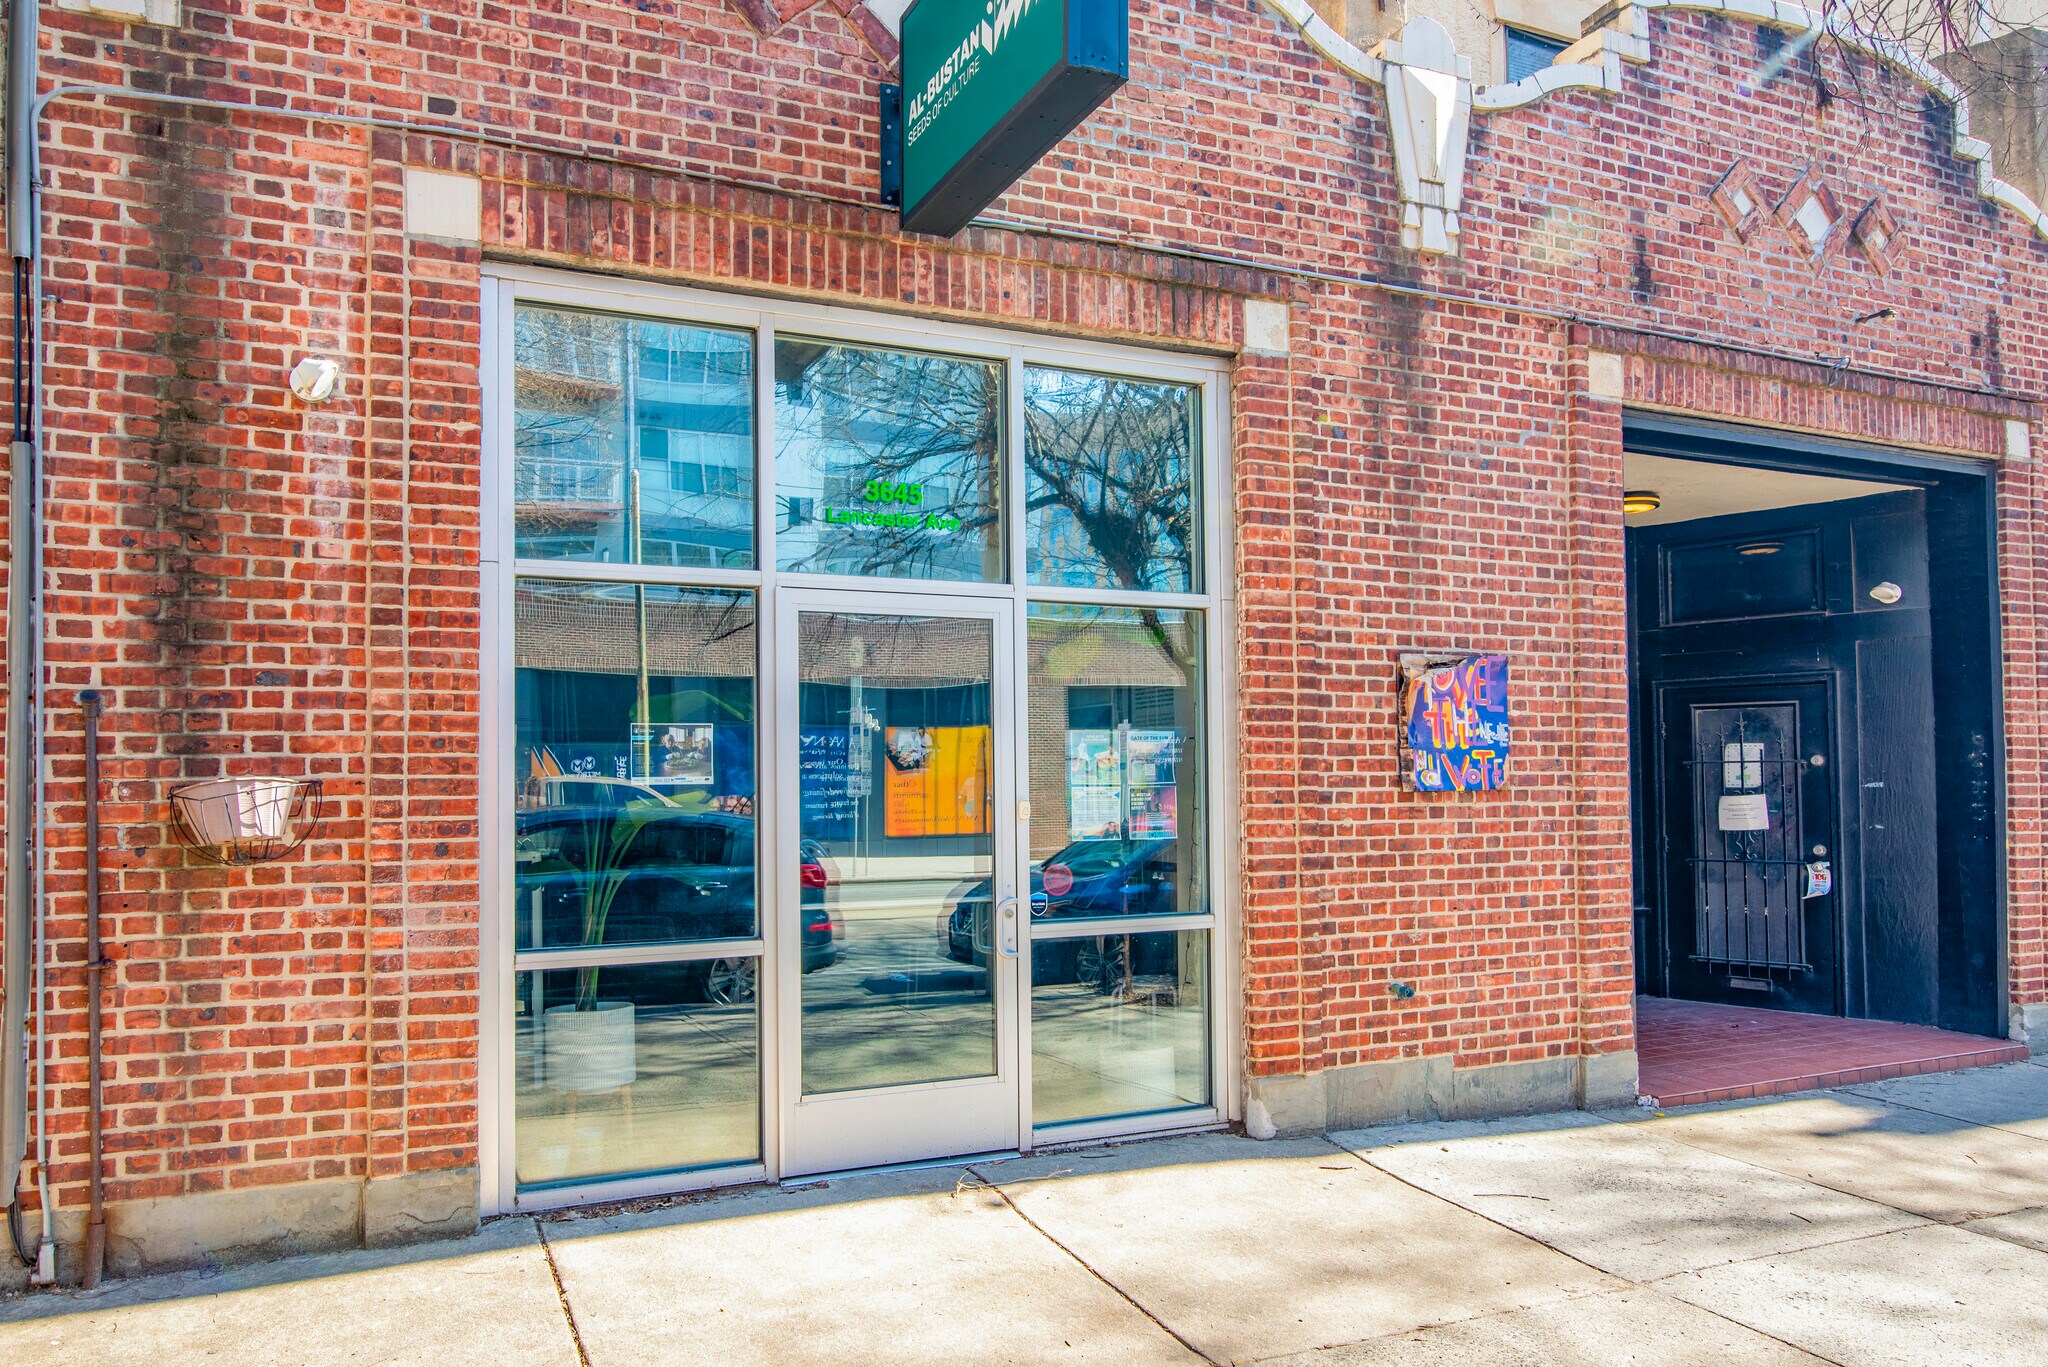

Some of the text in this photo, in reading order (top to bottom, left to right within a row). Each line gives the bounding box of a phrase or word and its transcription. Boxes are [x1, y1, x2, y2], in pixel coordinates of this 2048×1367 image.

[908, 24, 980, 127] AL-BUSTAN
[908, 54, 980, 147] SEEDS OF CULTURE
[826, 506, 961, 531] Lancaster Ave
[864, 480, 923, 505] 3645
